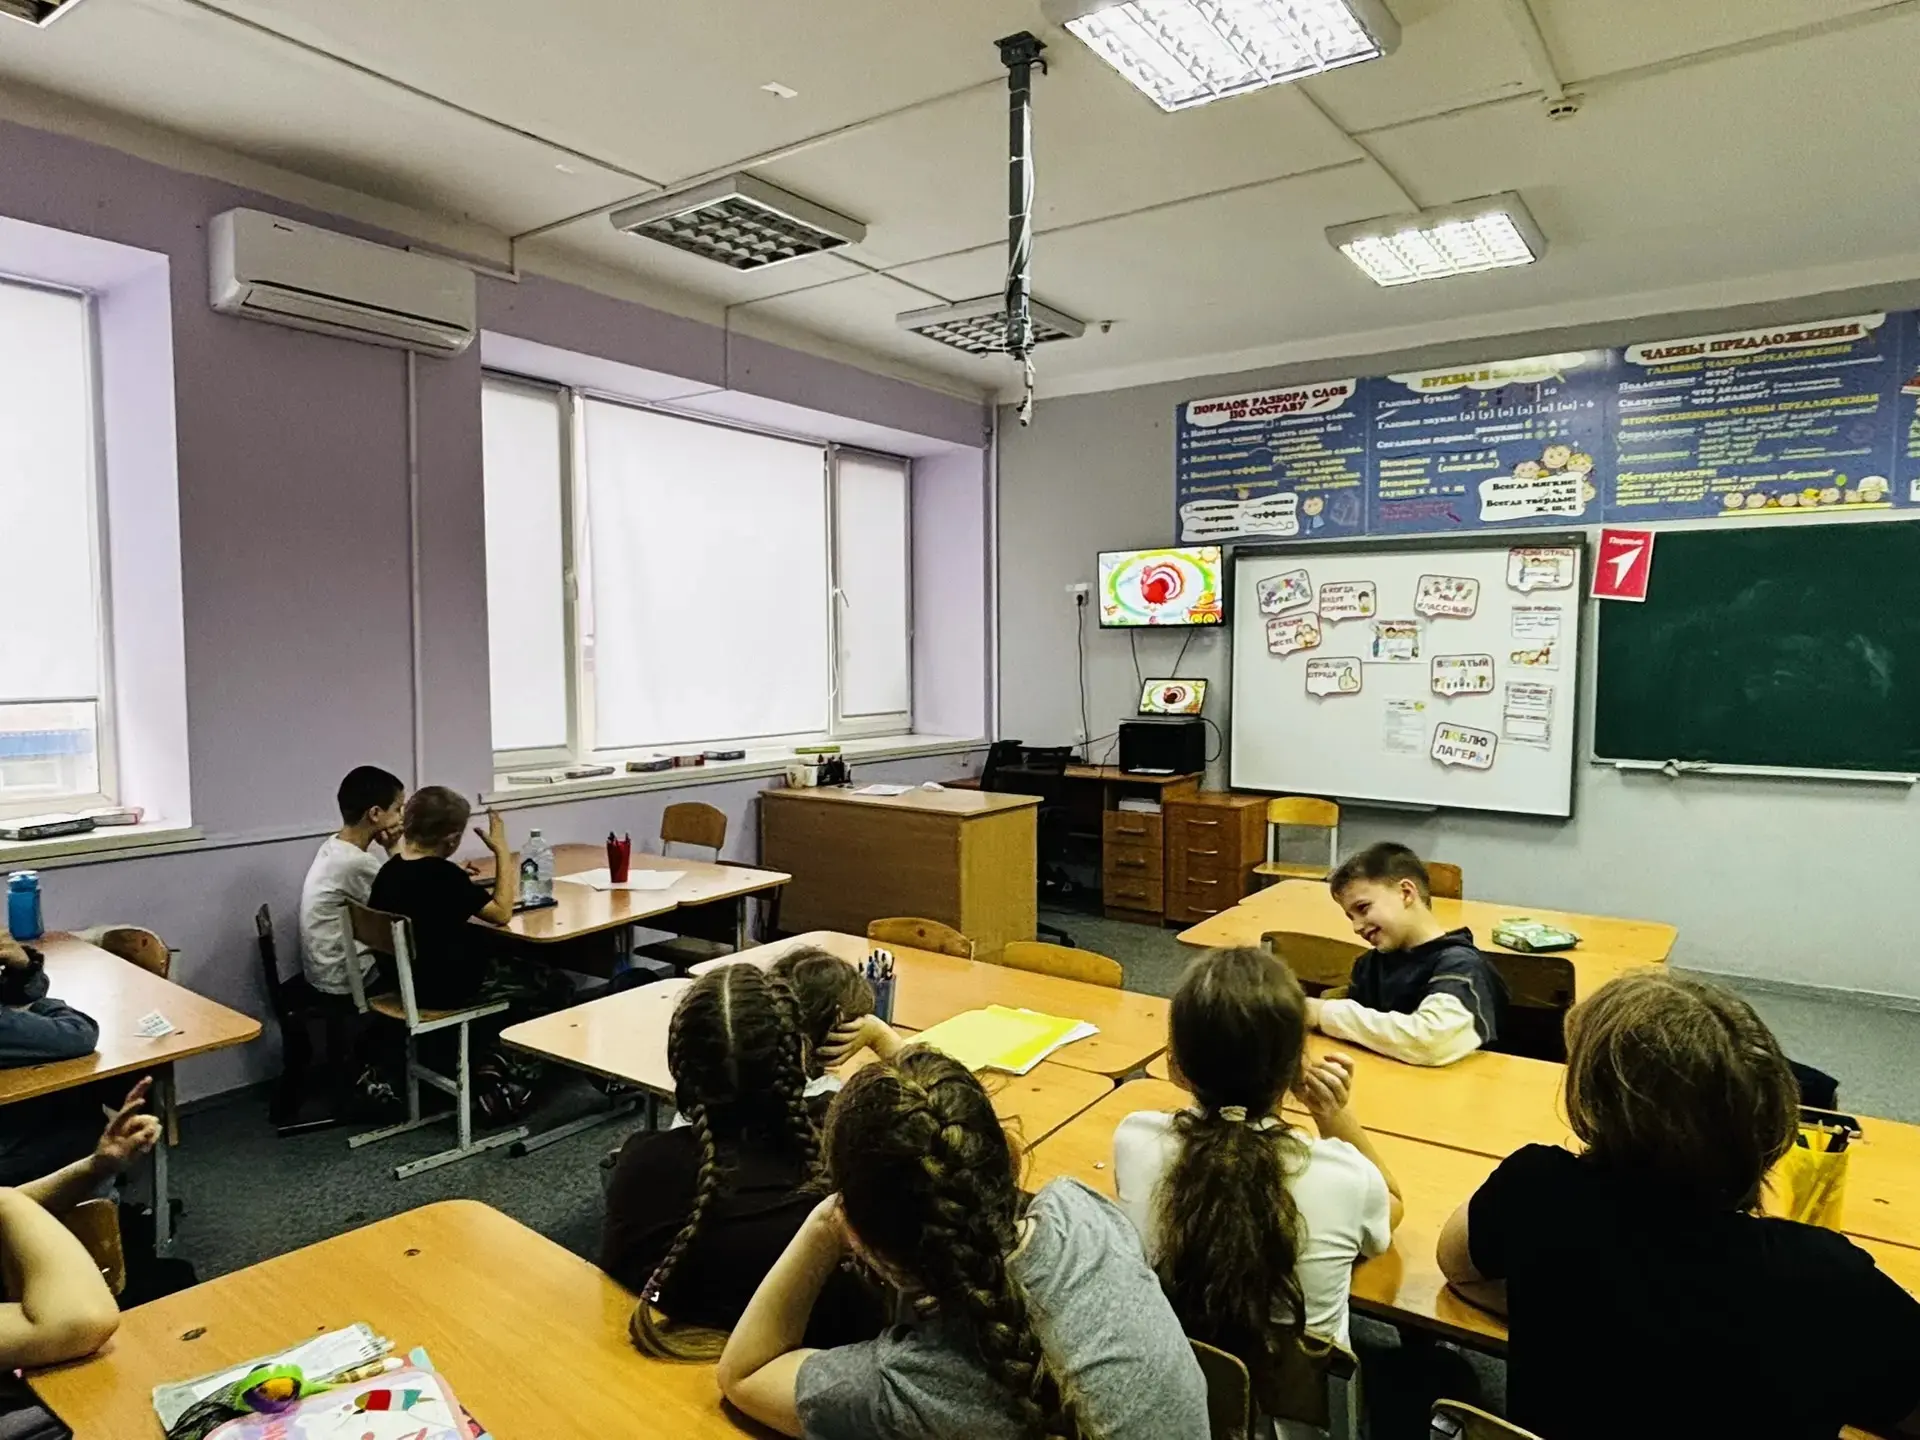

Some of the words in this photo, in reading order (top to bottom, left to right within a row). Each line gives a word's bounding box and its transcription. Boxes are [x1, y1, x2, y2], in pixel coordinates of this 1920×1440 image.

[1641, 343, 1705, 360] ЧЛЕНЫ
[1710, 324, 1860, 352] ПРЕДЛОЖЕНИЯ
[1193, 398, 1249, 415] ПОРЯДОК
[1252, 391, 1309, 406] РАЗБОРА
[1312, 386, 1348, 398] СЛОВ
[1229, 409, 1246, 419] ПО
[1249, 401, 1307, 417] СОСТАВУ
[1493, 483, 1528, 491] Всегда
[1532, 480, 1577, 488] мягкие:
[1440, 729, 1488, 747] ЛЮБЛЮ
